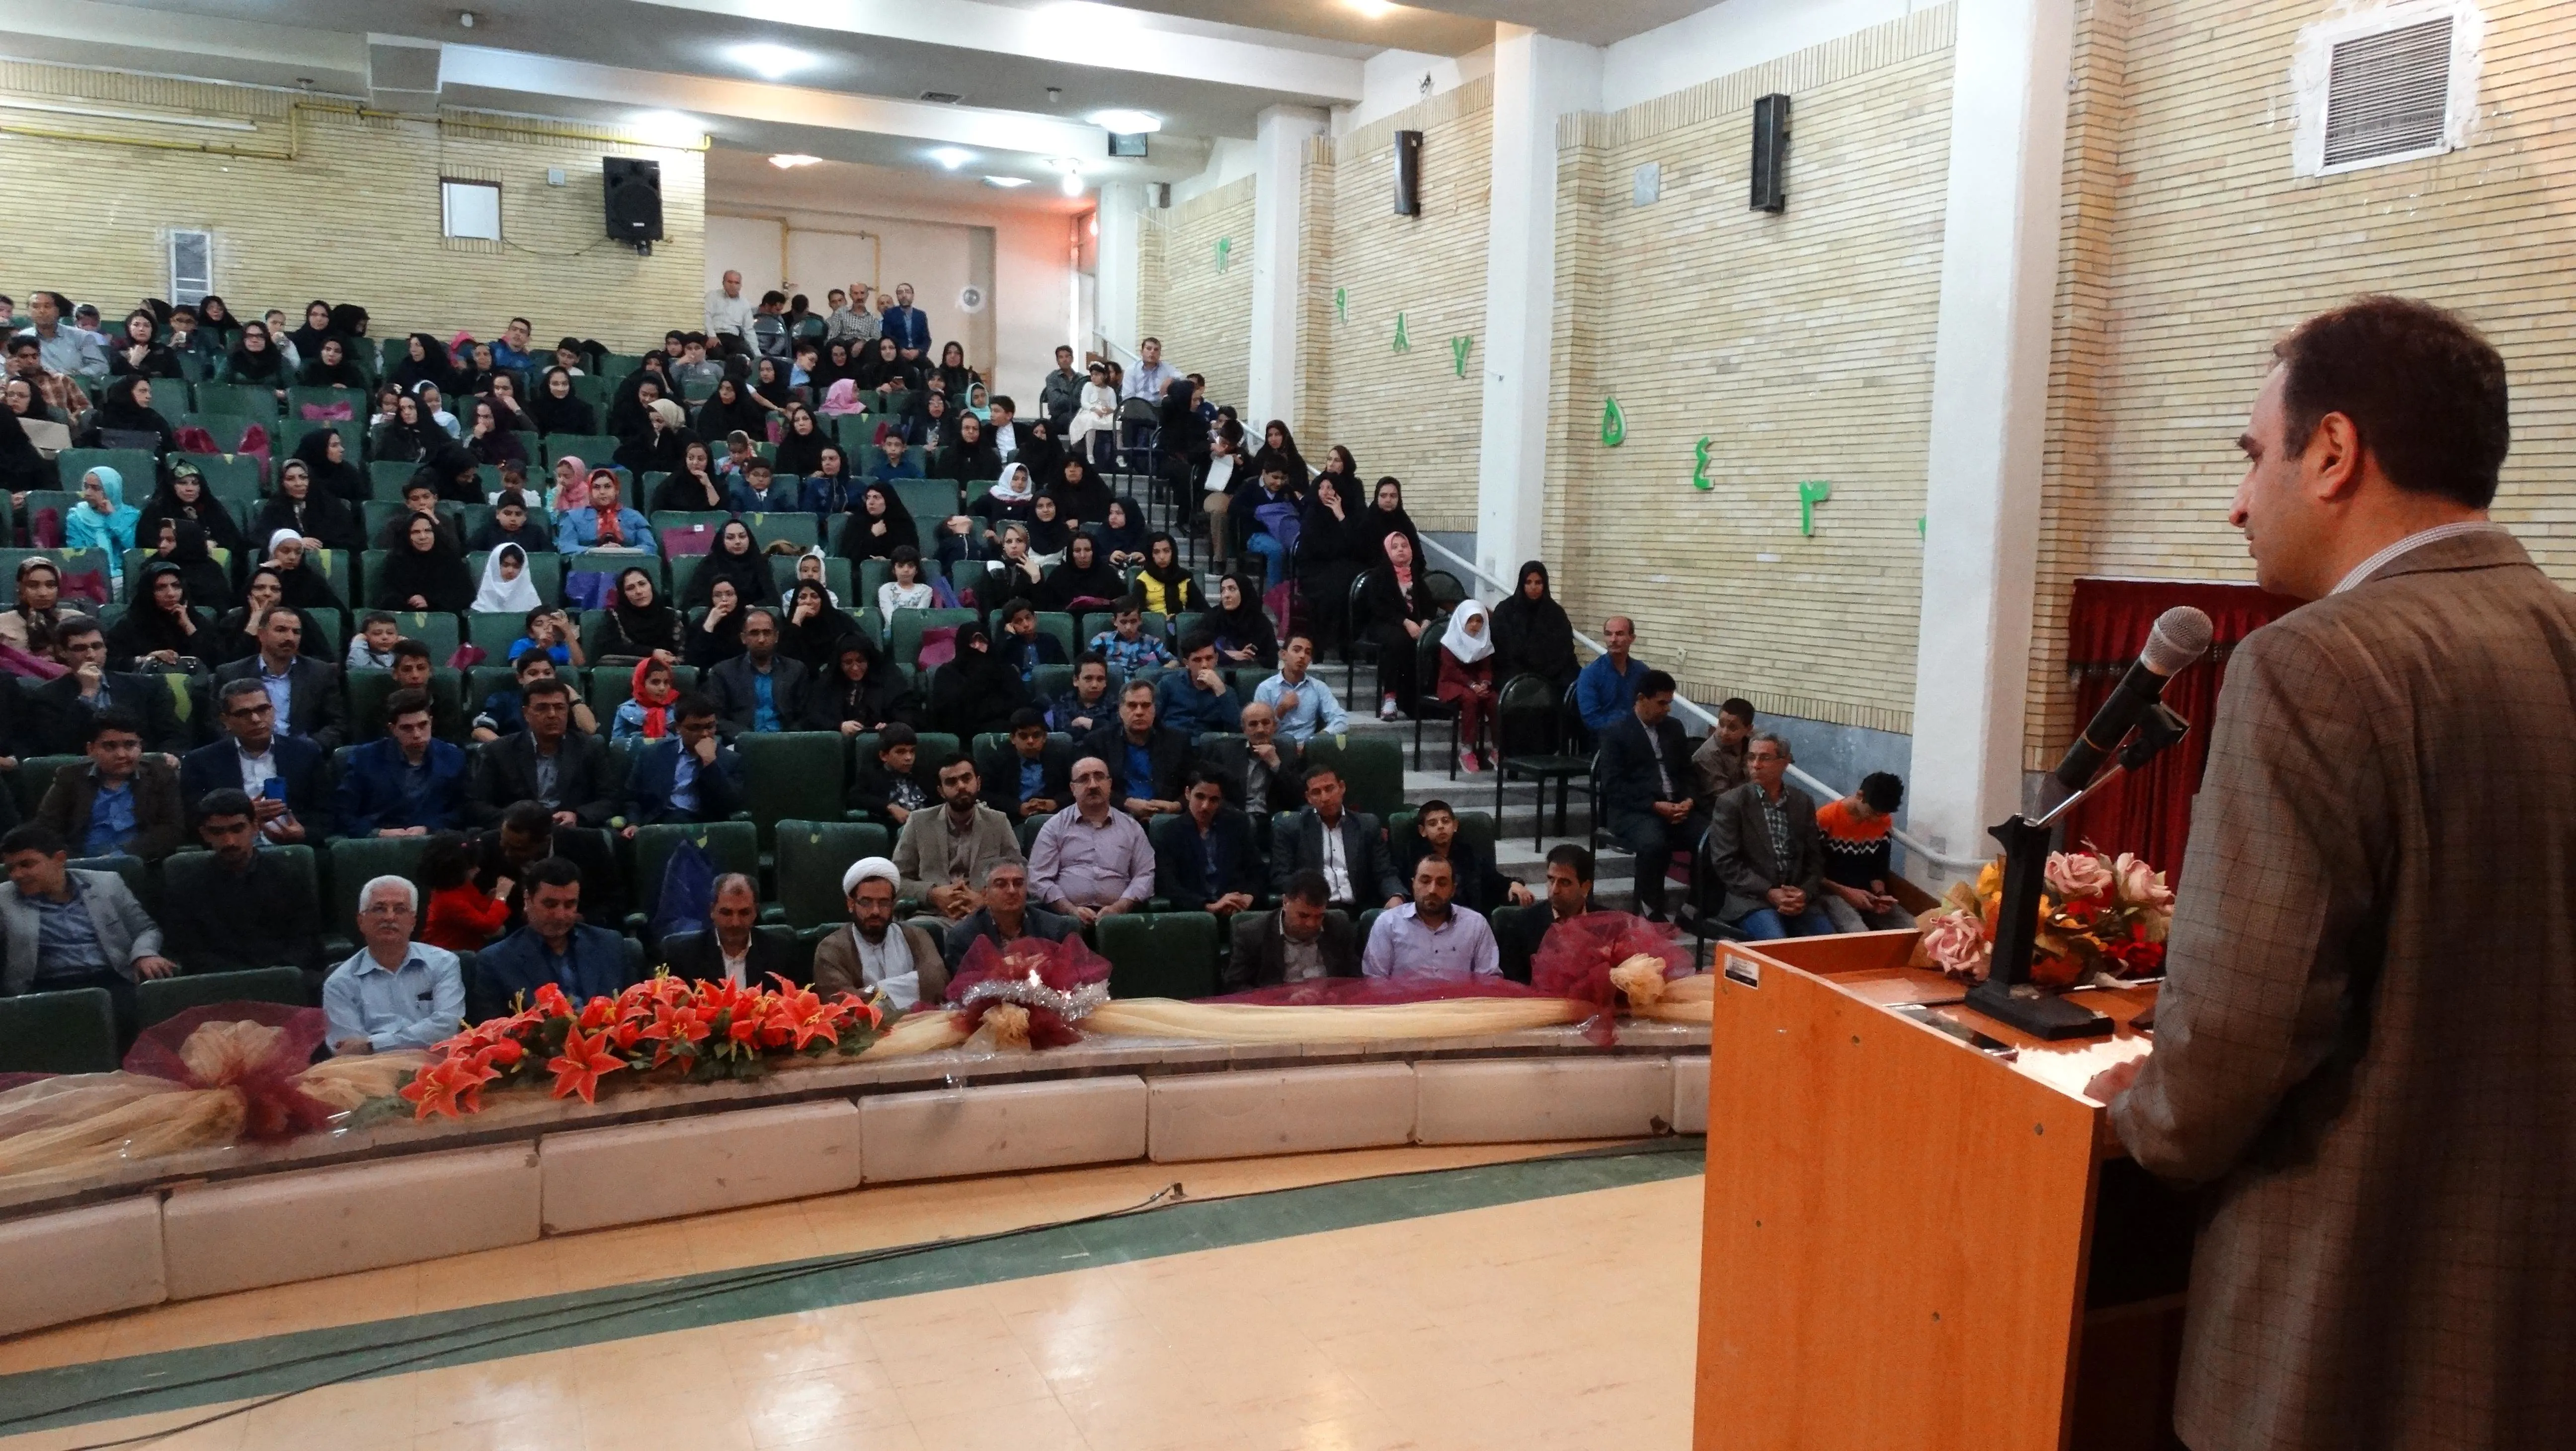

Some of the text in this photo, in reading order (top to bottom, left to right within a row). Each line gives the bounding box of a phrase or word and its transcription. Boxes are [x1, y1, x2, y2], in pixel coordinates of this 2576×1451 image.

[1337, 288, 1348, 326] ۹
[1392, 312, 1411, 352] ۸
[1451, 336, 1473, 378] ۷
[1602, 396, 1626, 446] ۵
